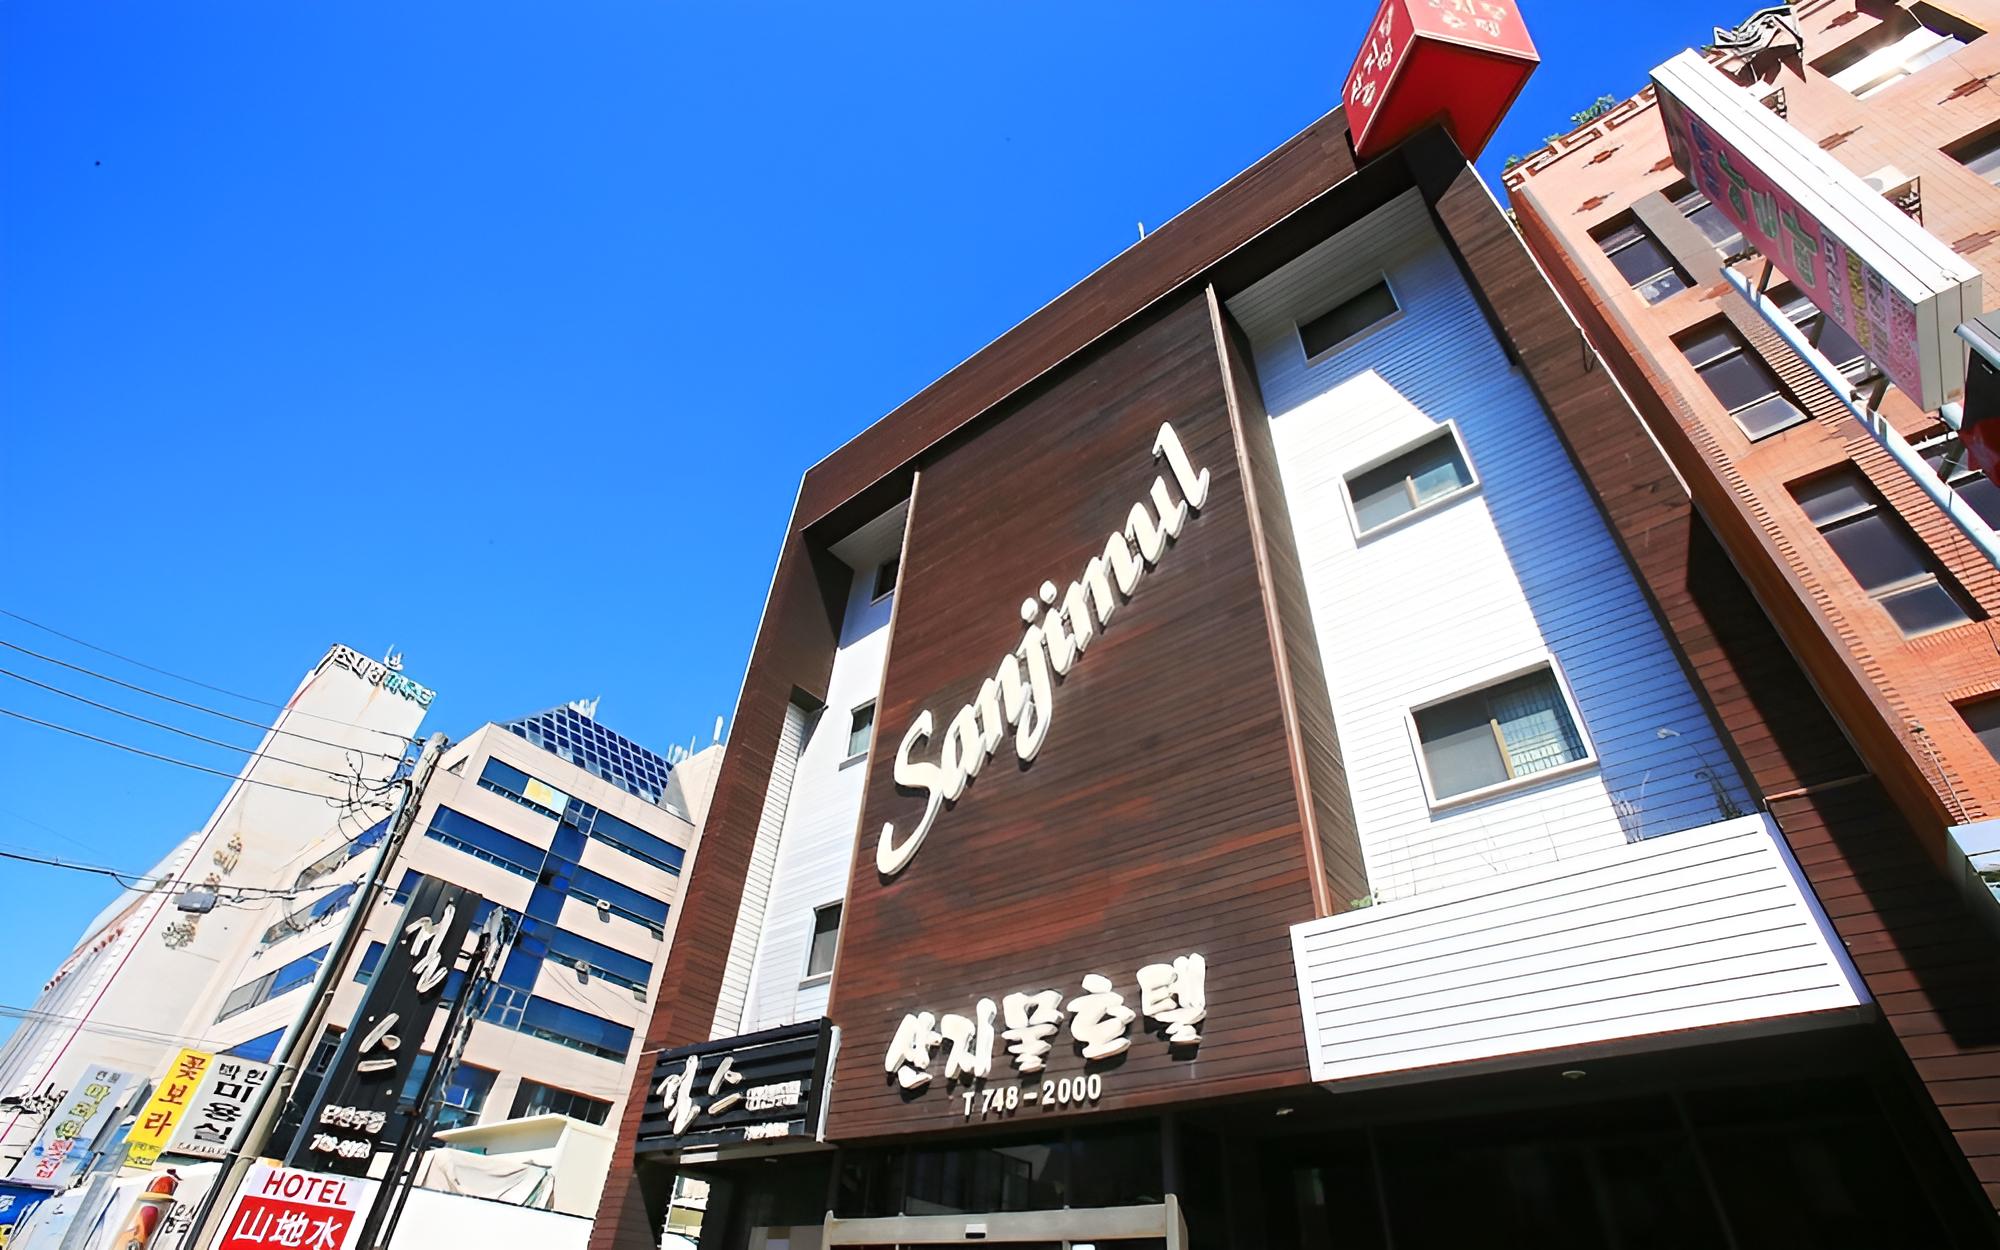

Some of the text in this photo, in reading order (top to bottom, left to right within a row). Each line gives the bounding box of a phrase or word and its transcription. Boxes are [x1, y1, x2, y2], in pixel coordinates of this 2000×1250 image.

[875, 420, 1210, 876] Sanjimul
[143, 1054, 206, 1138] 꽃보라
[193, 1080, 255, 1145] 미용실
[962, 1073, 1102, 1116] T 748-2000
[262, 1169, 348, 1206] HOTEL
[231, 1206, 344, 1250] 山地水
